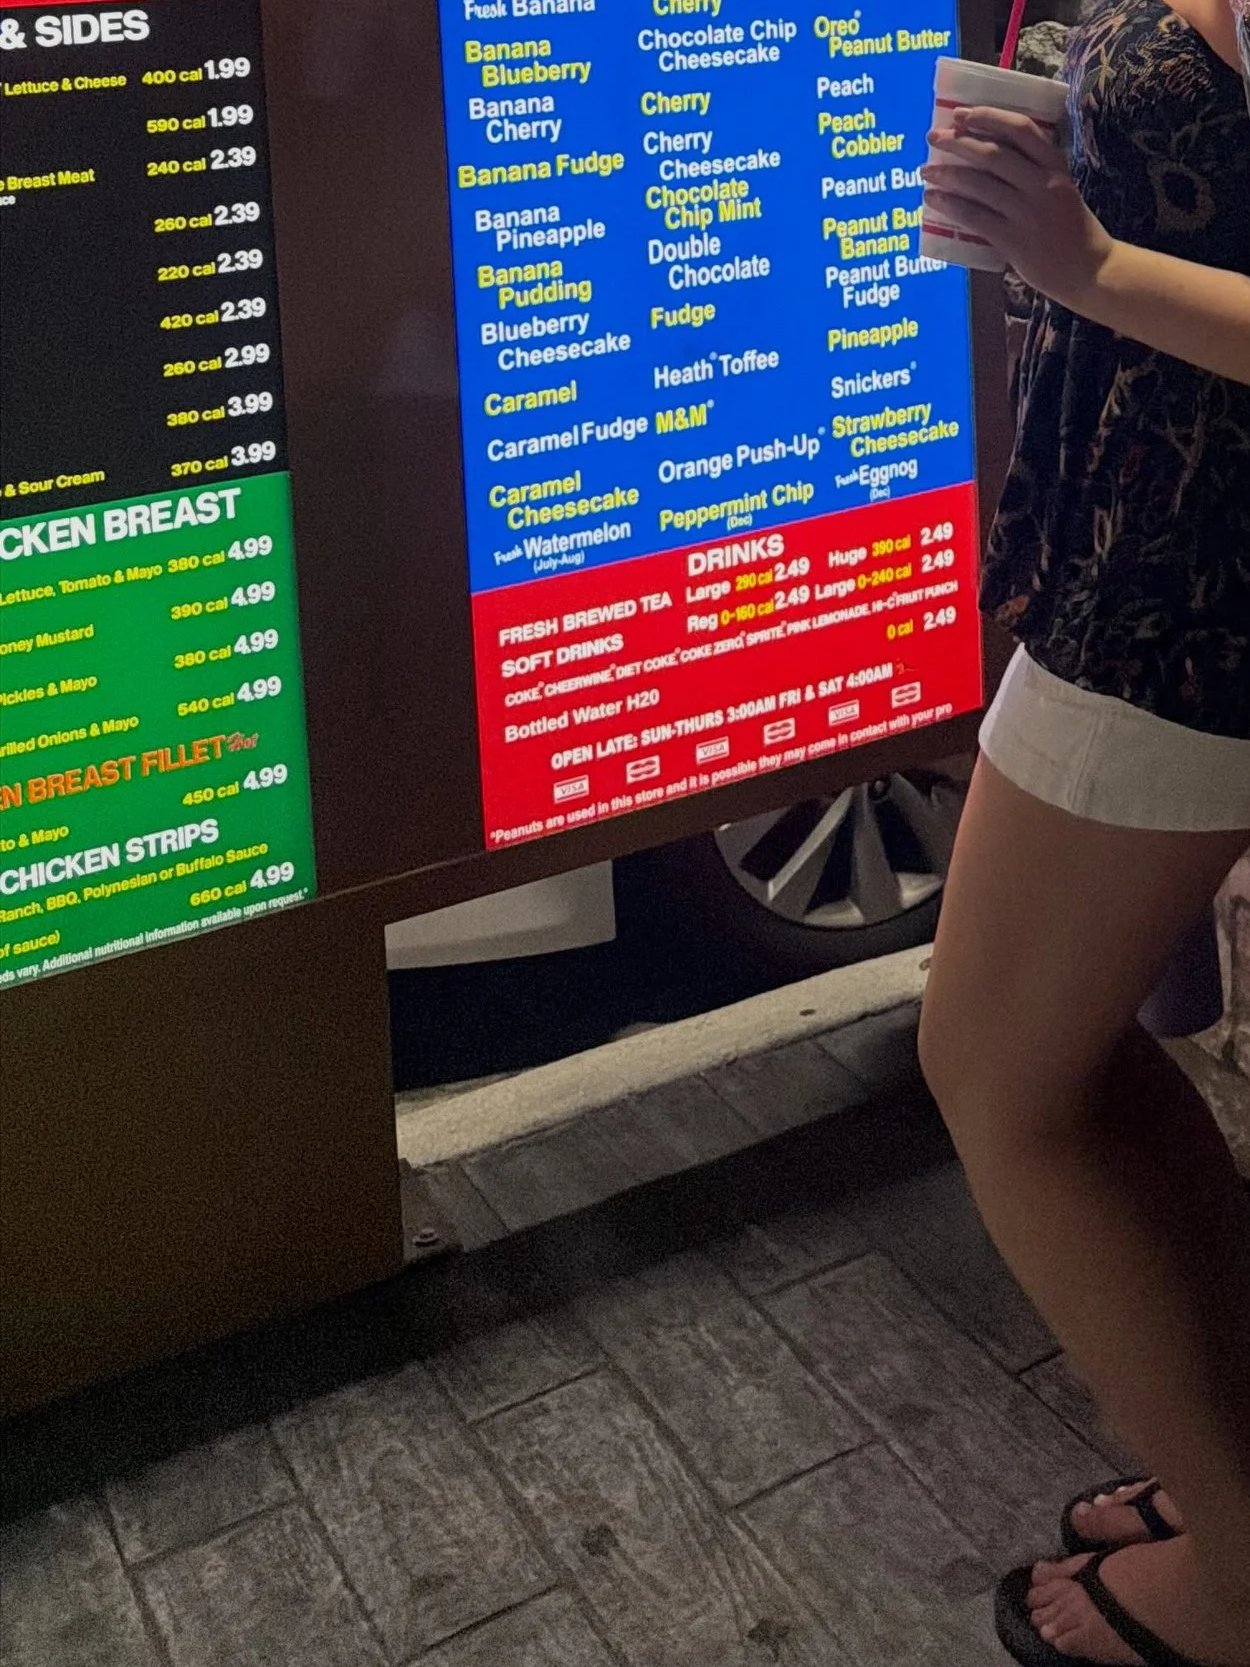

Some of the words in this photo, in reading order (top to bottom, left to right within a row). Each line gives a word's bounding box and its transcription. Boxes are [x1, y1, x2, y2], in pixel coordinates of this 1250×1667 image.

[0, 18, 28, 49] &
[35, 10, 150, 47] SIDES
[829, 33, 892, 57] Peanut
[897, 29, 951, 51] Butter
[465, 39, 551, 63] Banana
[5, 80, 59, 96] Lettuce
[61, 78, 72, 91] &
[74, 75, 127, 90] Cheese
[142, 70, 176, 84] 400
[179, 68, 203, 82] cal
[204, 57, 250, 80] 1.99
[482, 60, 591, 87] Blueberry
[641, 92, 710, 117] Cherry
[819, 110, 876, 134] Peach
[832, 134, 904, 160] Cobbler
[7, 172, 56, 190] Breast
[57, 169, 95, 185] Meat
[147, 161, 180, 176] 240
[183, 159, 206, 172] cal
[210, 146, 257, 170] 2.39
[458, 162, 551, 188] Banana
[556, 151, 625, 181] Fudge
[647, 235, 721, 265] Double
[499, 280, 592, 310] Pudding
[828, 319, 918, 352] Pineapple
[484, 381, 577, 416] Caramel
[171, 460, 202, 477] 370
[205, 456, 228, 472] cal
[231, 441, 276, 466] 3.99
[859, 458, 918, 488] Eggnog
[5, 484, 16, 497] &
[18, 479, 54, 494] Sour
[56, 470, 105, 488] Cream
[104, 488, 241, 541] BREAST
[659, 489, 767, 532] Peppermint
[772, 481, 814, 507] Chip
[727, 514, 753, 530] (Dec)
[523, 520, 631, 558] Watermelon
[687, 534, 784, 577] DRINKS
[59, 575, 111, 594] Tomato
[114, 571, 124, 583] &
[126, 564, 162, 581] Mayo
[168, 556, 199, 573] 380
[202, 551, 225, 566] cal
[228, 535, 273, 561] 4.99
[533, 552, 585, 574] (July-Aug)
[499, 620, 559, 647] FRESH
[563, 601, 636, 633] BREWED
[640, 592, 672, 615] TEA
[686, 579, 731, 605] Large
[736, 574, 756, 591] 290
[758, 570, 773, 587] cal
[774, 558, 810, 582] 2.49
[829, 547, 867, 569] Huge
[872, 540, 894, 557] 390
[895, 535, 911, 552] cal
[921, 522, 953, 545] 2.49
[36, 624, 94, 648] Mustard
[501, 651, 553, 678] SOFT
[556, 634, 624, 665] DRINKS
[505, 714, 570, 743] Bottled
[573, 699, 625, 726] Water
[887, 624, 896, 640] 0
[898, 619, 913, 636] cal
[923, 607, 955, 631] 2.49
[551, 747, 593, 770] OPEN
[597, 735, 639, 758] LATE:
[641, 710, 724, 747] SUN-THURS
[727, 696, 776, 724] 3:00AM
[779, 689, 801, 708] FRI
[805, 686, 815, 702] &
[819, 677, 843, 698] SAT
[846, 664, 893, 691] 4:00AM
[27, 756, 136, 800] BREAST
[141, 736, 225, 776] FILLET
[0, 843, 121, 894] CHICKEN
[125, 819, 219, 863] STRIPS
[46, 892, 81, 910] BBQ,
[83, 872, 157, 901] Polynesian
[159, 867, 173, 880] or
[175, 854, 224, 876] Buffalo
[226, 843, 269, 864] Sauce
[42, 947, 92, 972] Additional
[94, 933, 144, 957] nutritional
[145, 920, 199, 943] information
[201, 908, 241, 928] available
[243, 902, 267, 917] upon
